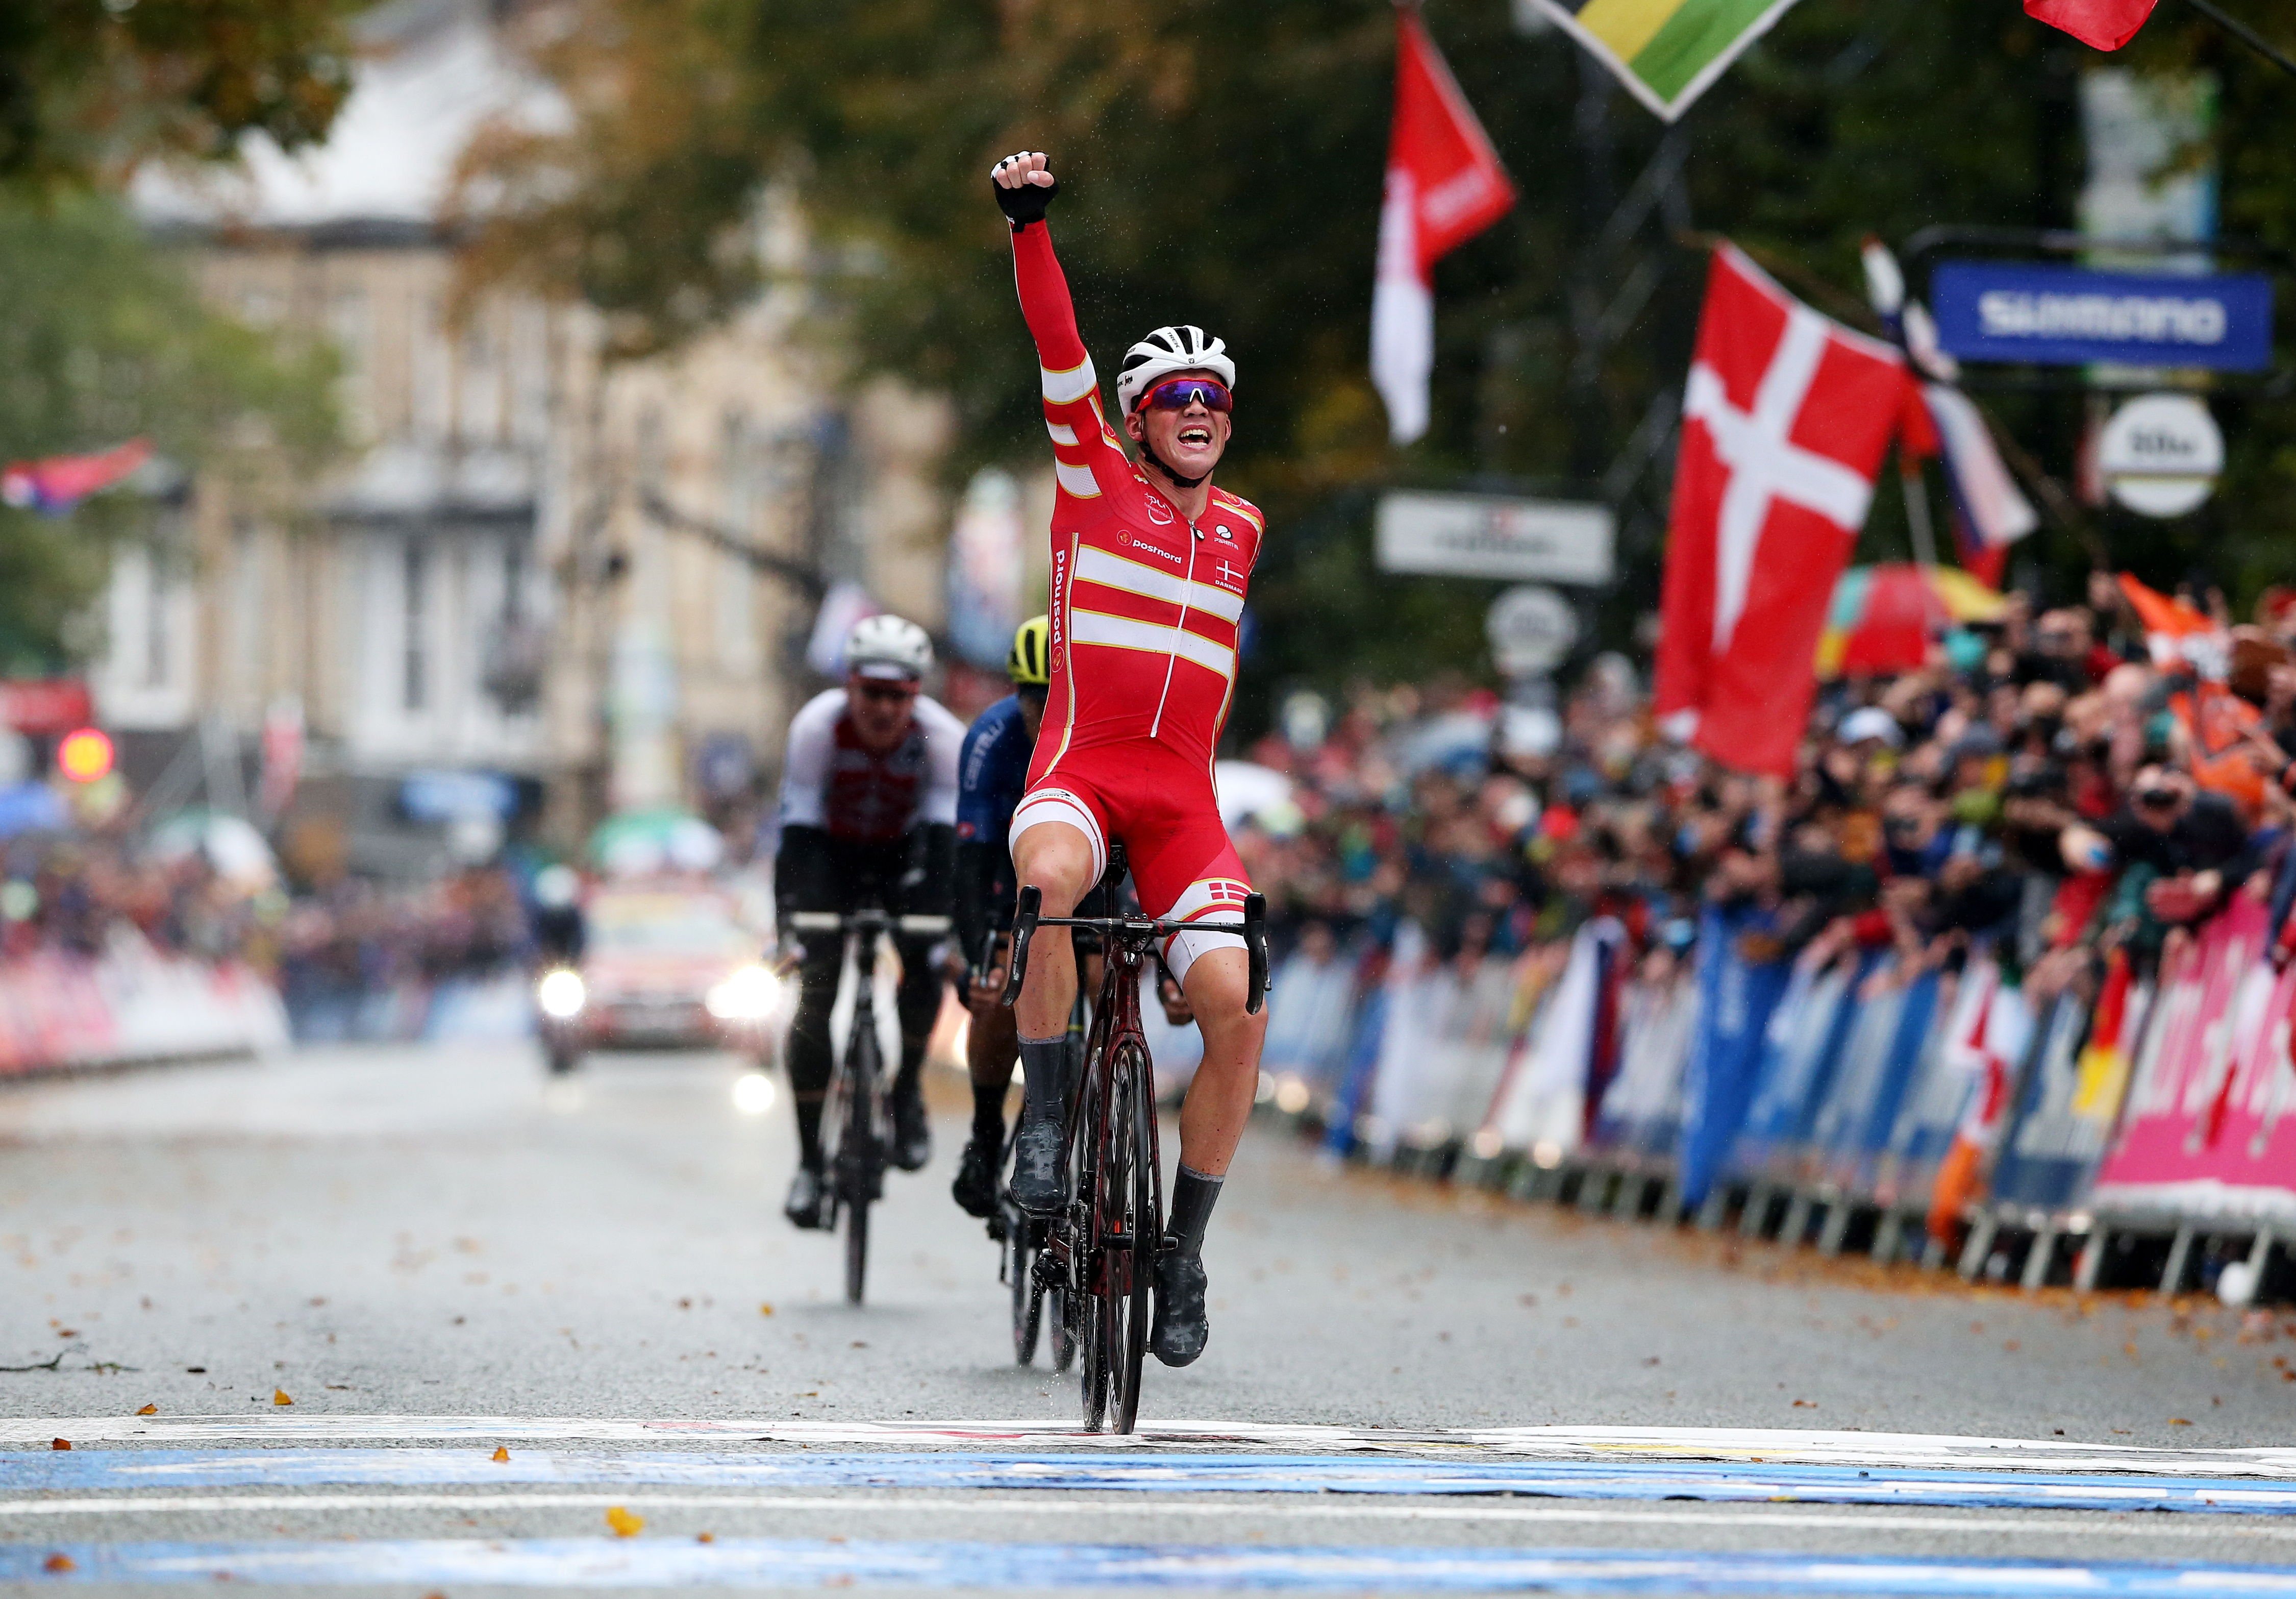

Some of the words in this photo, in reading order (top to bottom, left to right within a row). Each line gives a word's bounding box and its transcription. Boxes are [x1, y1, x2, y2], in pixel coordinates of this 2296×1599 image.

[1167, 332, 1180, 348] TREK
[1132, 539, 1182, 564] postnord
[1054, 549, 1065, 644] postnord
[1215, 579, 1243, 595] DANMARK
